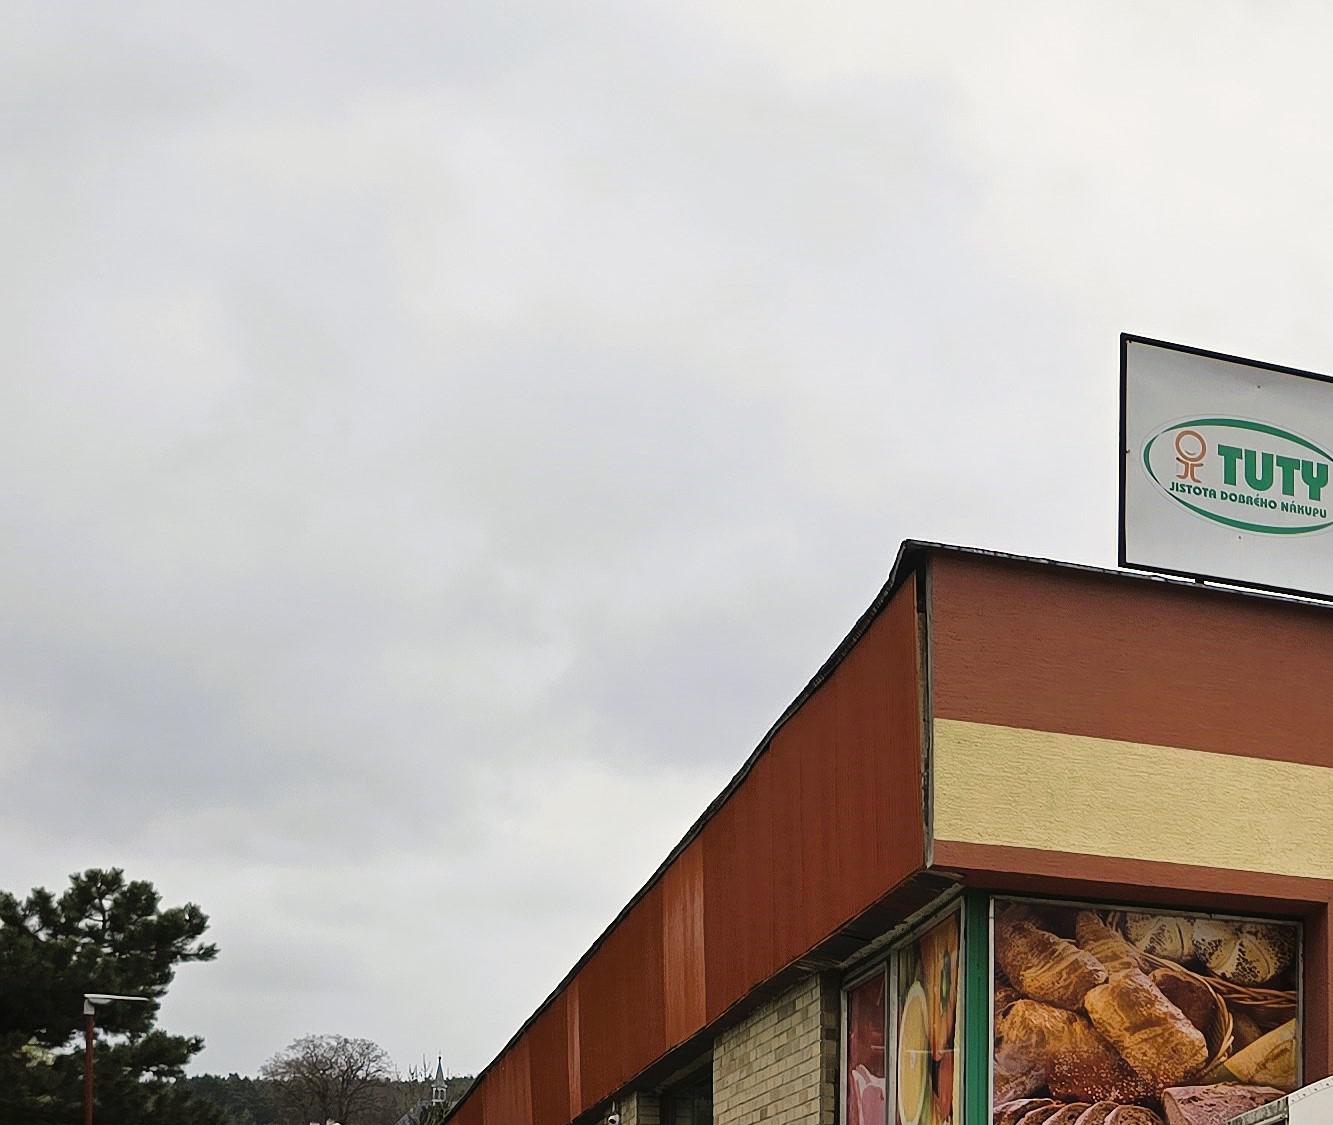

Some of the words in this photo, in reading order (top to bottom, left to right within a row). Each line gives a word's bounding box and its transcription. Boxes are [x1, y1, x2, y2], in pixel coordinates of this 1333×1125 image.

[1217, 443, 1329, 502] TUTY
[1169, 481, 1217, 499] JISTOTA
[1220, 490, 1277, 510] DOBRÉHO
[1280, 501, 1327, 518] NÁKUPU
